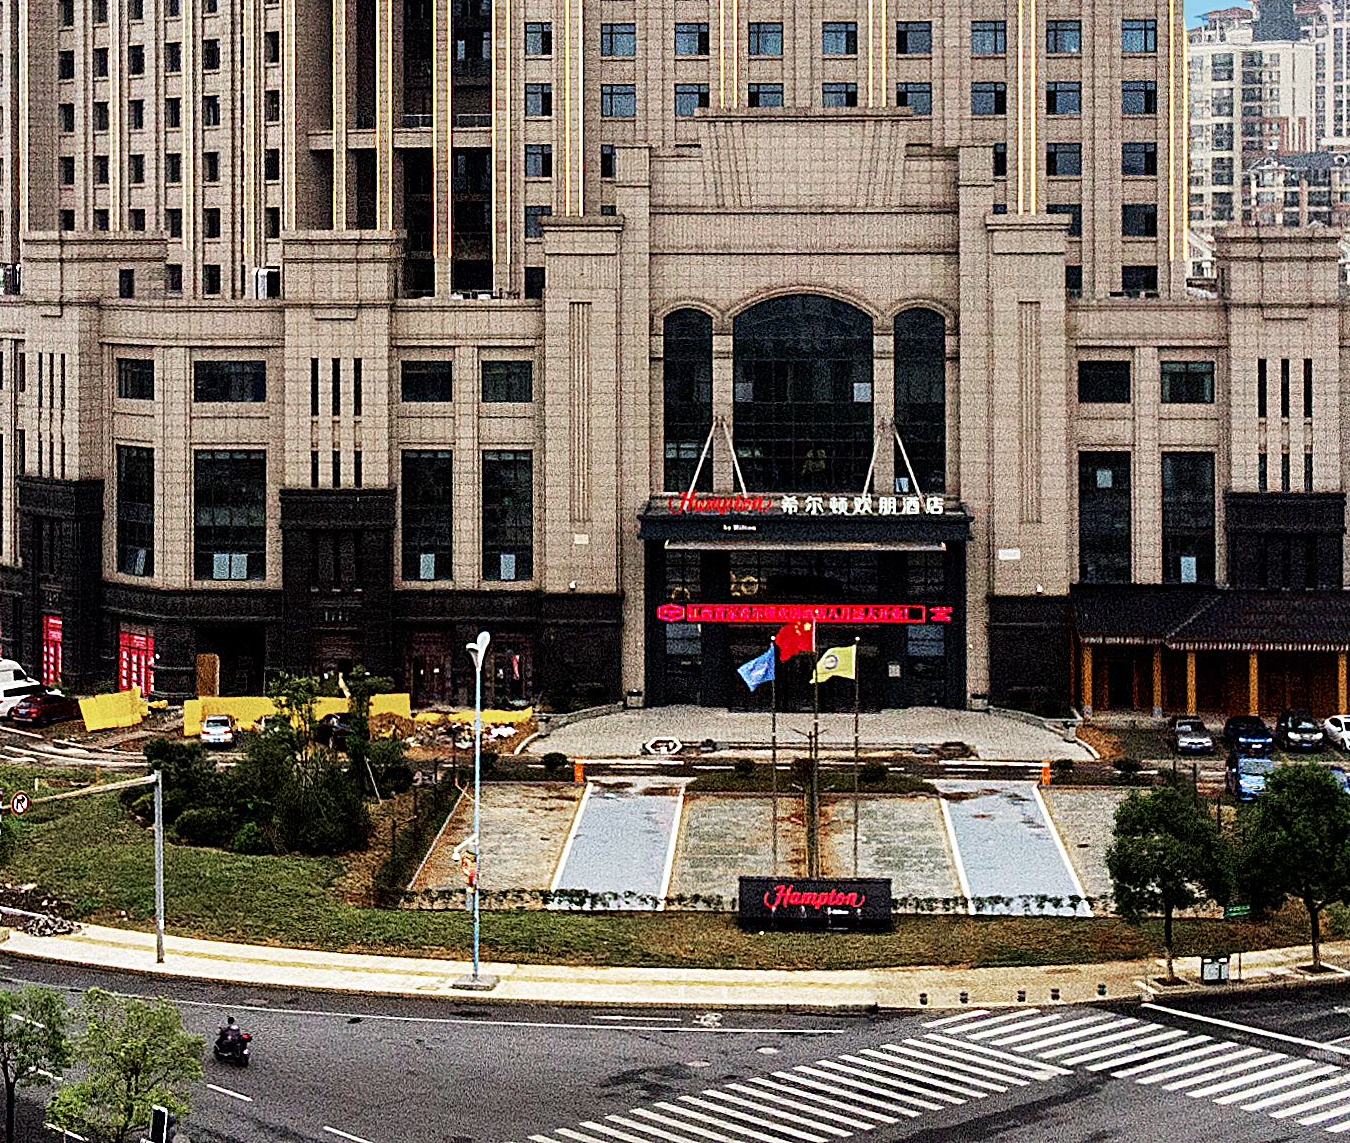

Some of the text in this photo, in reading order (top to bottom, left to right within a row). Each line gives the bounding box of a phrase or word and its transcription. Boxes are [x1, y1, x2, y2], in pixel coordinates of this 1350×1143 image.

[668, 489, 945, 516] Hampton 希尔顿欢朋酒店
[763, 884, 866, 910] Hampton
